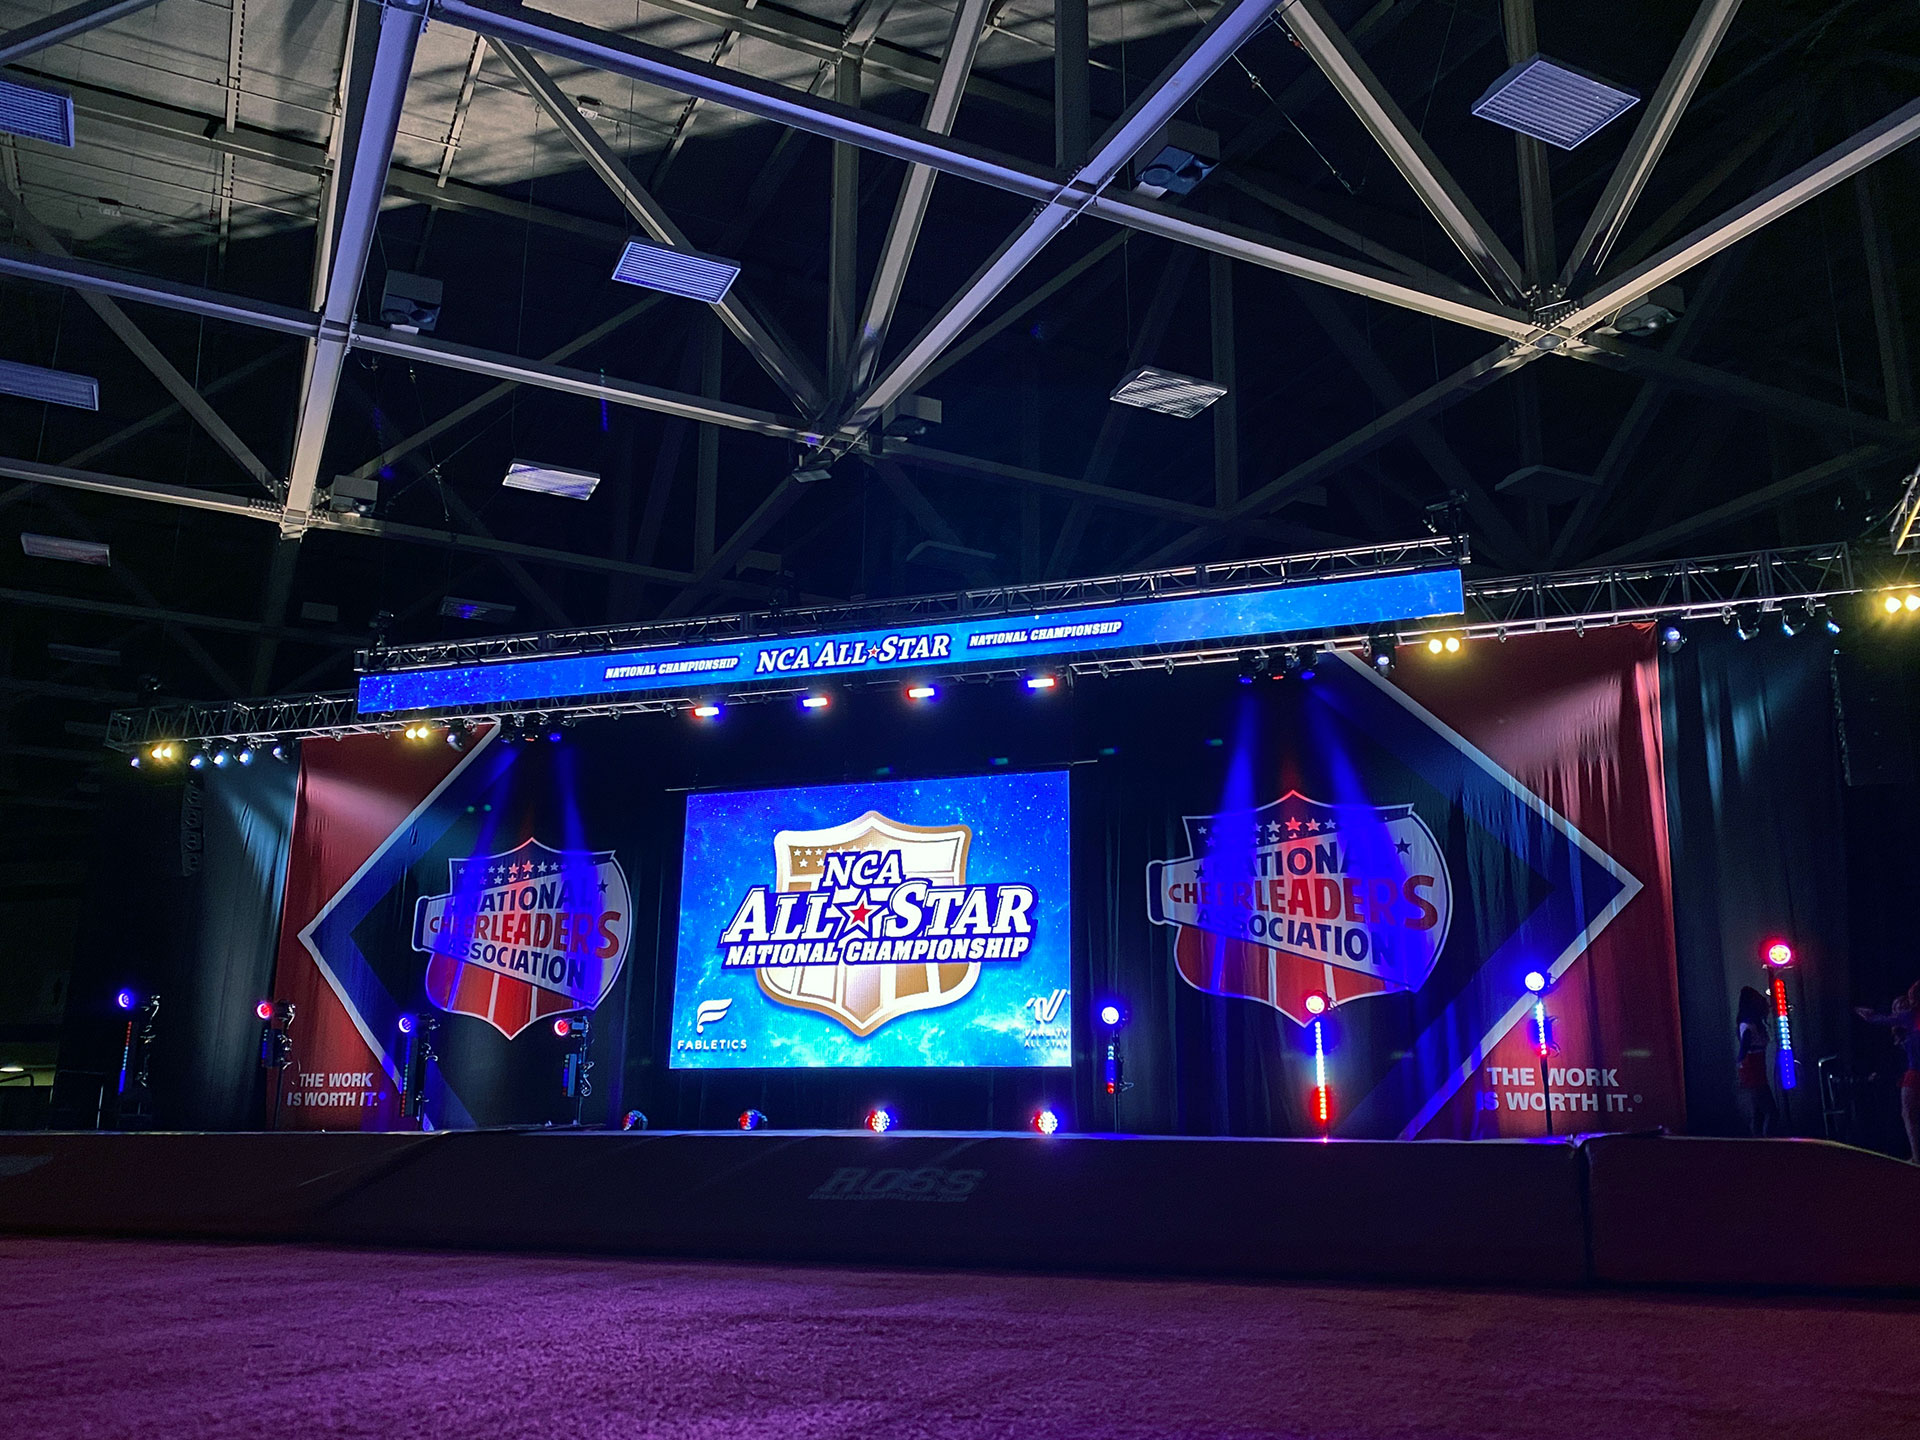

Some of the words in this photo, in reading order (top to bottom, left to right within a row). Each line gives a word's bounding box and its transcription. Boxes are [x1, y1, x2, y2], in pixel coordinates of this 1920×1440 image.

[970, 631, 1028, 647] NATIONAL
[1030, 621, 1122, 641] CHAMPIONSHIP
[756, 647, 810, 673] NCA
[814, 641, 868, 668] ALL
[878, 635, 950, 662] STAR
[605, 664, 657, 679] NATIONAL
[658, 657, 739, 674] CHAMPIONSHIP
[823, 851, 902, 887] NCA
[721, 887, 836, 944] ALL
[884, 880, 1034, 938] STAR
[429, 911, 621, 959] CHRLEADERS
[1197, 908, 1396, 966] AOCIATION
[726, 943, 840, 967] NATIONAL
[843, 936, 1030, 963] CHAMPIONSHIP
[677, 1039, 747, 1051] FABLETICS
[299, 1073, 325, 1088] THE
[328, 1073, 373, 1088] WORK
[1487, 1067, 1535, 1086] THE
[1547, 1067, 1619, 1087] WORK
[287, 1092, 302, 1107] IS
[304, 1092, 357, 1107] WORTH
[1476, 1091, 1499, 1111] IS
[1506, 1092, 1599, 1112] WORTH
[815, 1167, 985, 1194] ROSS
